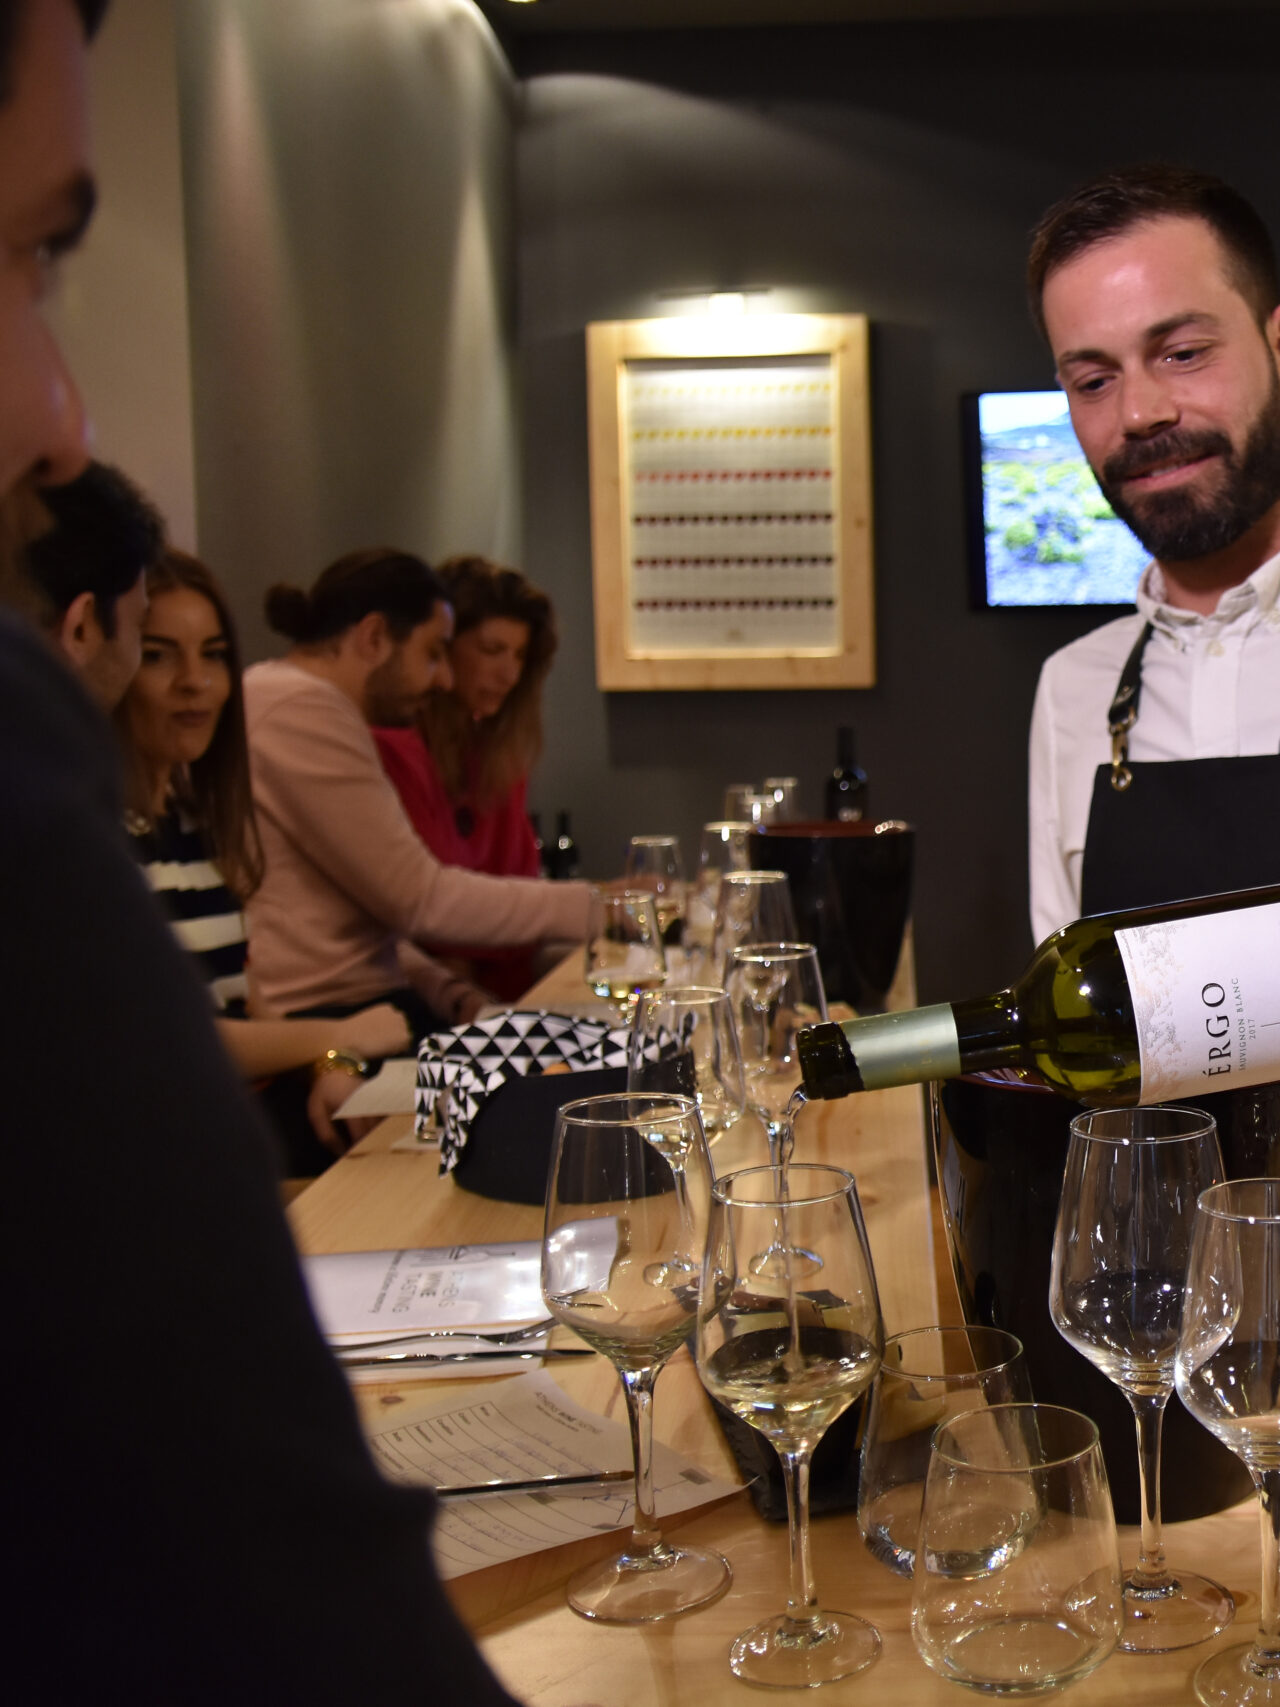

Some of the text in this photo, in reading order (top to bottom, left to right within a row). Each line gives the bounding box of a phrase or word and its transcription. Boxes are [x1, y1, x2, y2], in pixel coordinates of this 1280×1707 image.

[1201, 982, 1232, 1078] ÉRGO
[1231, 977, 1247, 1071] SAUVIGNON BLANC
[1247, 1018, 1256, 1040] 2017
